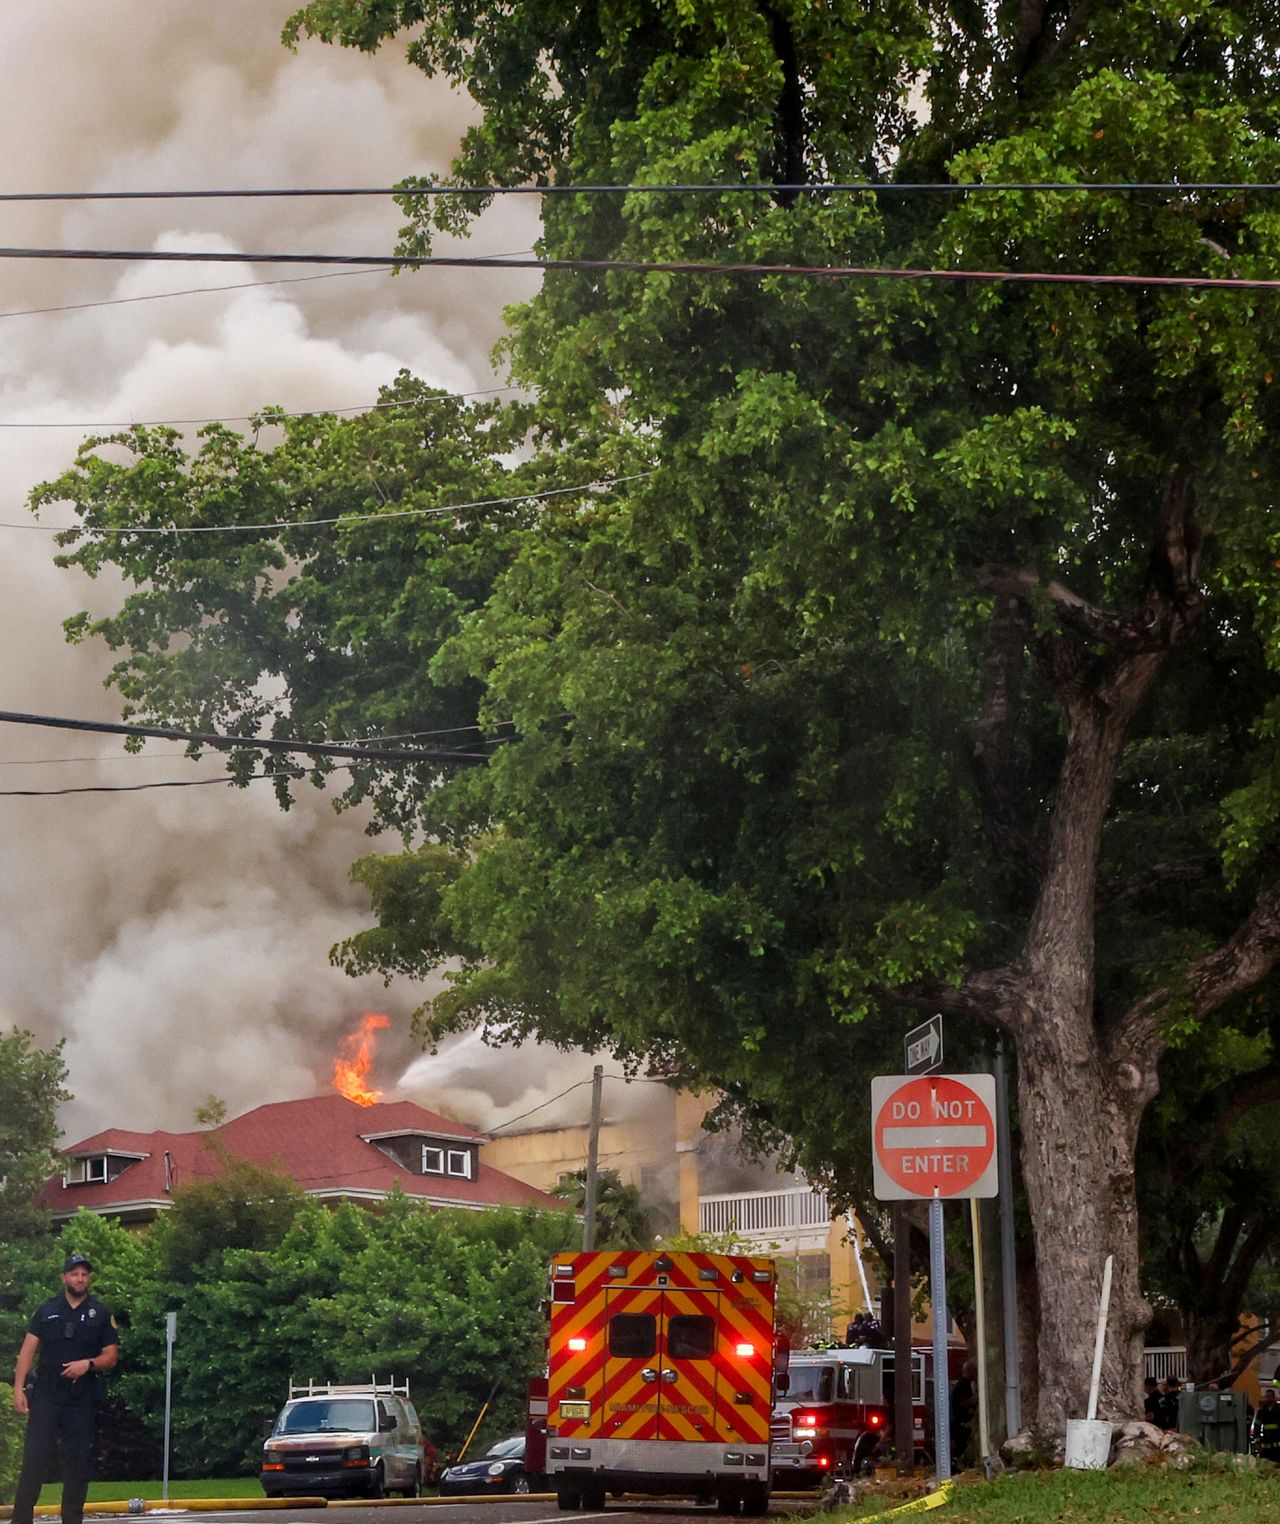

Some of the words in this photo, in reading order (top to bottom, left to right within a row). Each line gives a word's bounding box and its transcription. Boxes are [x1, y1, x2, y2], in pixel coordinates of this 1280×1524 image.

[892, 1101, 920, 1120] DO
[934, 1100, 975, 1119] NOT
[901, 1154, 969, 1174] ENTER
